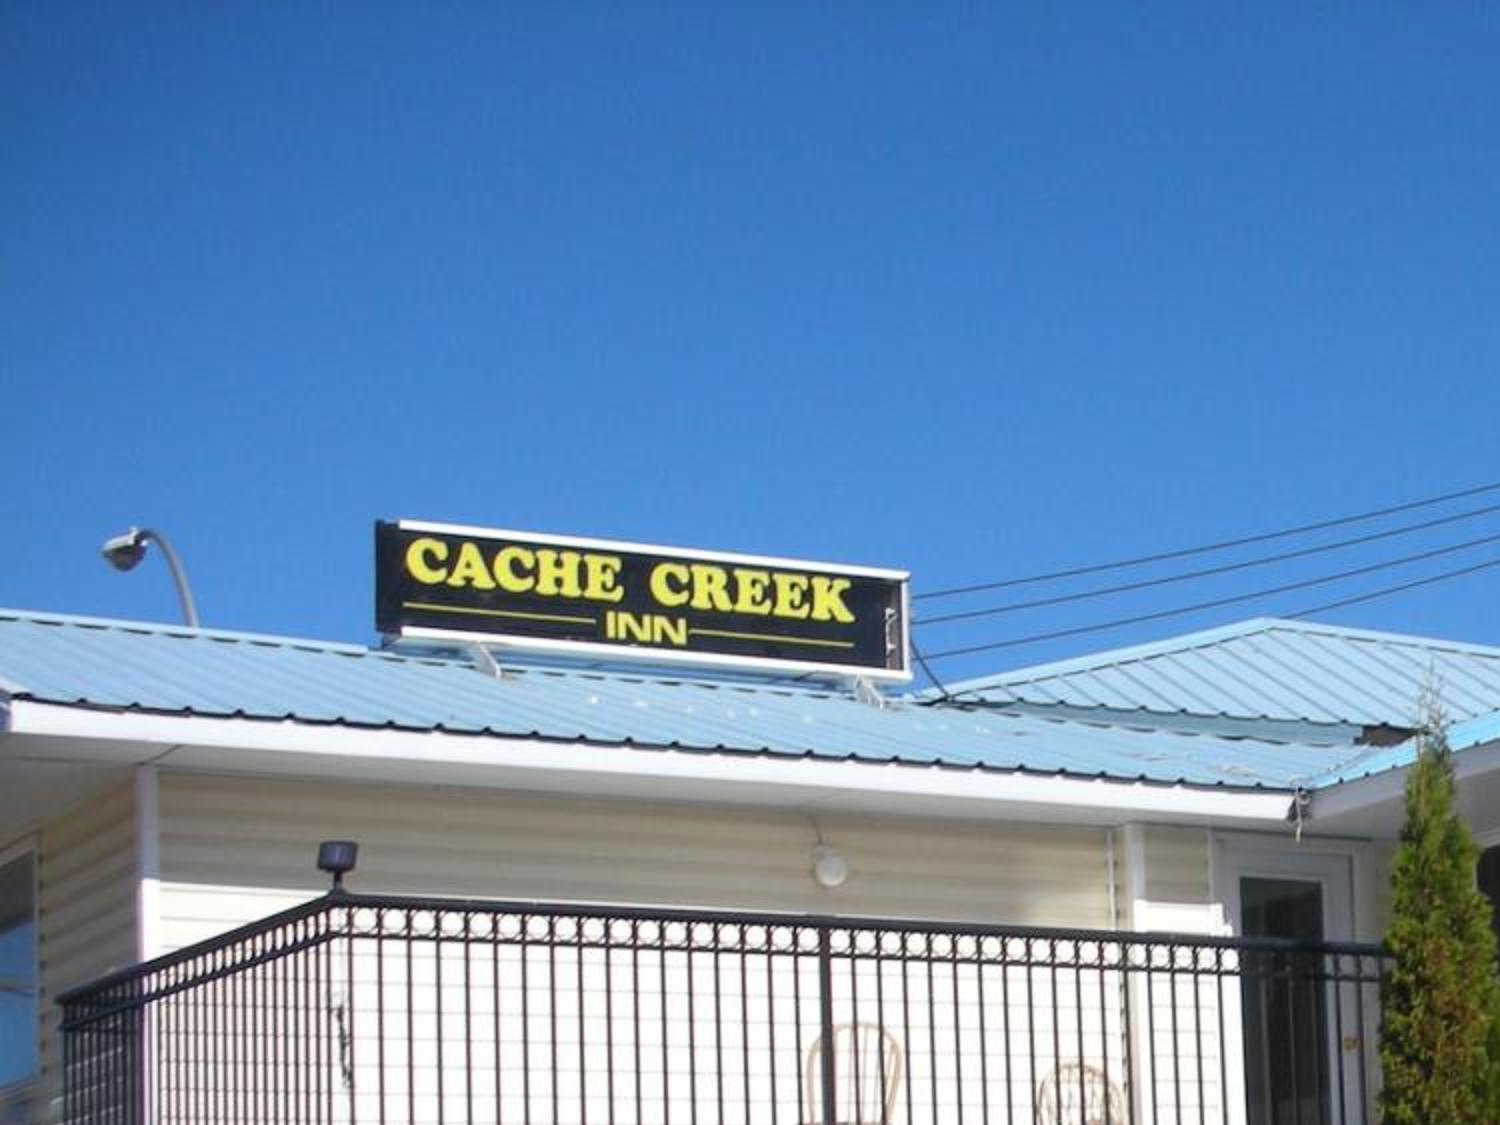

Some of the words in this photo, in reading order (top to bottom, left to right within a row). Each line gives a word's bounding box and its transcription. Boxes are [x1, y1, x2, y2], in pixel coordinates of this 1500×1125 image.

[406, 538, 624, 602] CACHE
[650, 563, 855, 623] CREEK
[606, 610, 688, 645] INN
